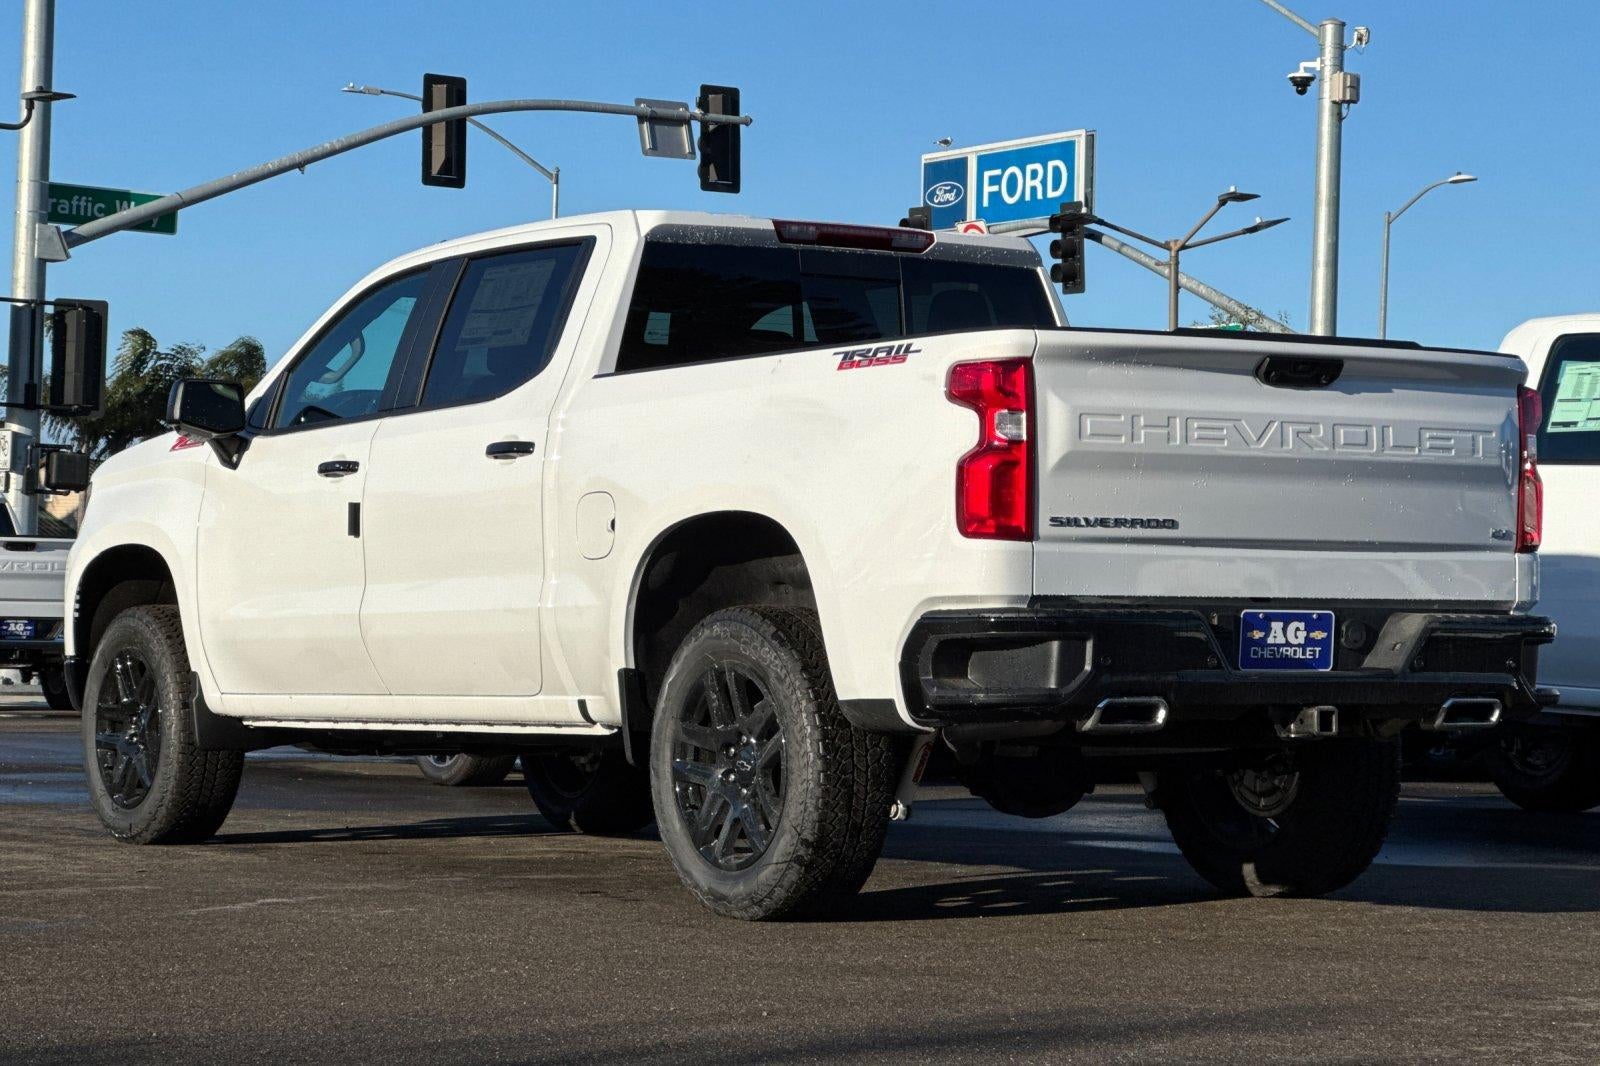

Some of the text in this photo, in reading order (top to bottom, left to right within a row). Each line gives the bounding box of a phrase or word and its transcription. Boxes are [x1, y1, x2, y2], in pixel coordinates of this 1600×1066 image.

[982, 159, 1068, 208] FORD
[933, 185, 958, 203] Ford
[48, 195, 105, 218] raffic
[832, 342, 922, 362] TRAIL
[837, 354, 909, 371] BOSS
[1078, 412, 1496, 458] CHEVROLET
[1048, 516, 1180, 530] SILVERADO
[1266, 621, 1308, 645] AG
[1250, 646, 1322, 659] CHEVROLET
